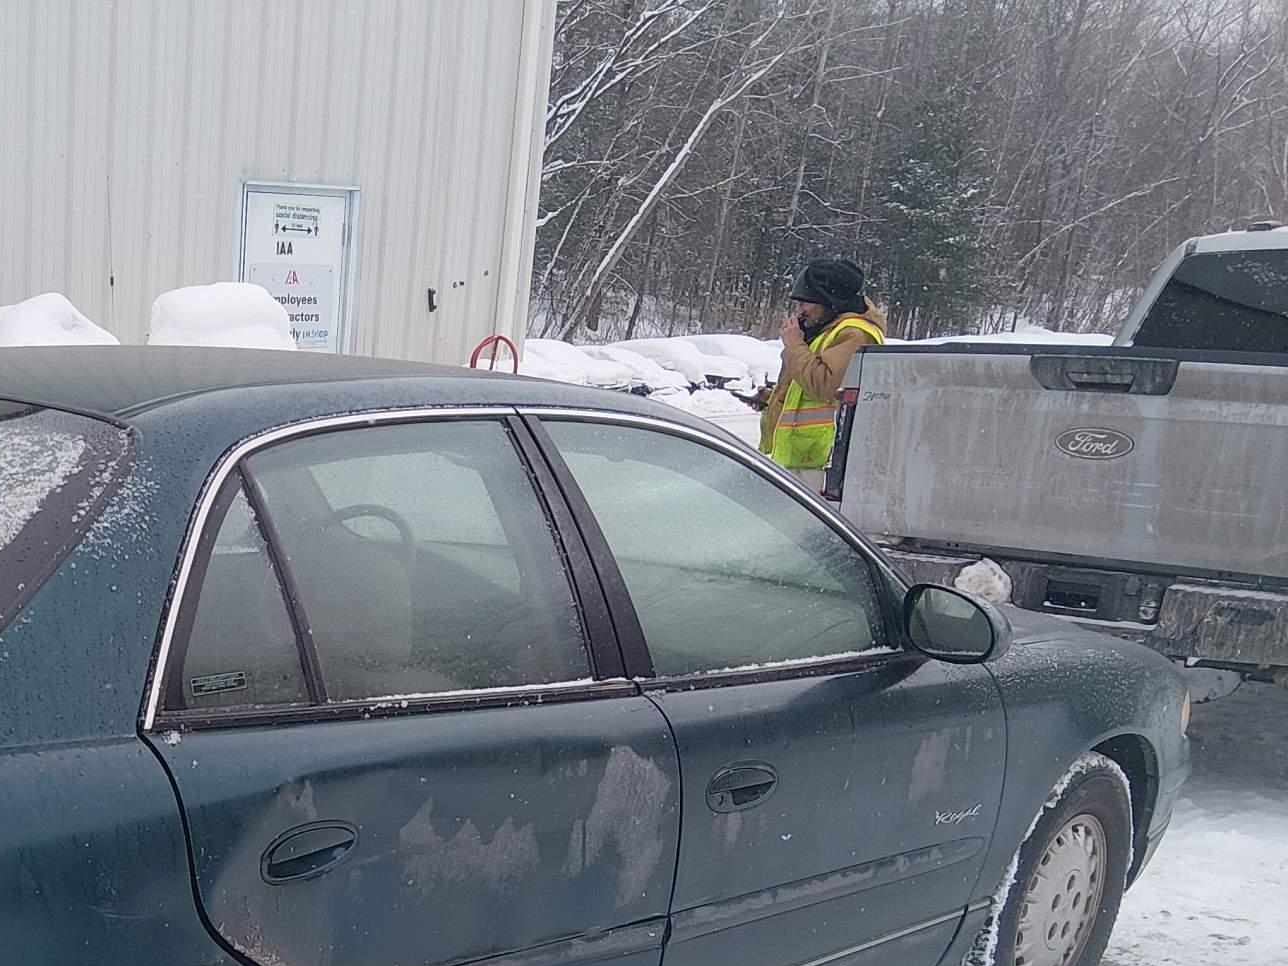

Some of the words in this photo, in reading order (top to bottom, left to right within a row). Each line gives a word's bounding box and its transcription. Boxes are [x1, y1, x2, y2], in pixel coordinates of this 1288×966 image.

[276, 241, 293, 255] IAA
[273, 293, 318, 307] mployees
[288, 312, 320, 322] actors
[1068, 432, 1119, 454] Ford
